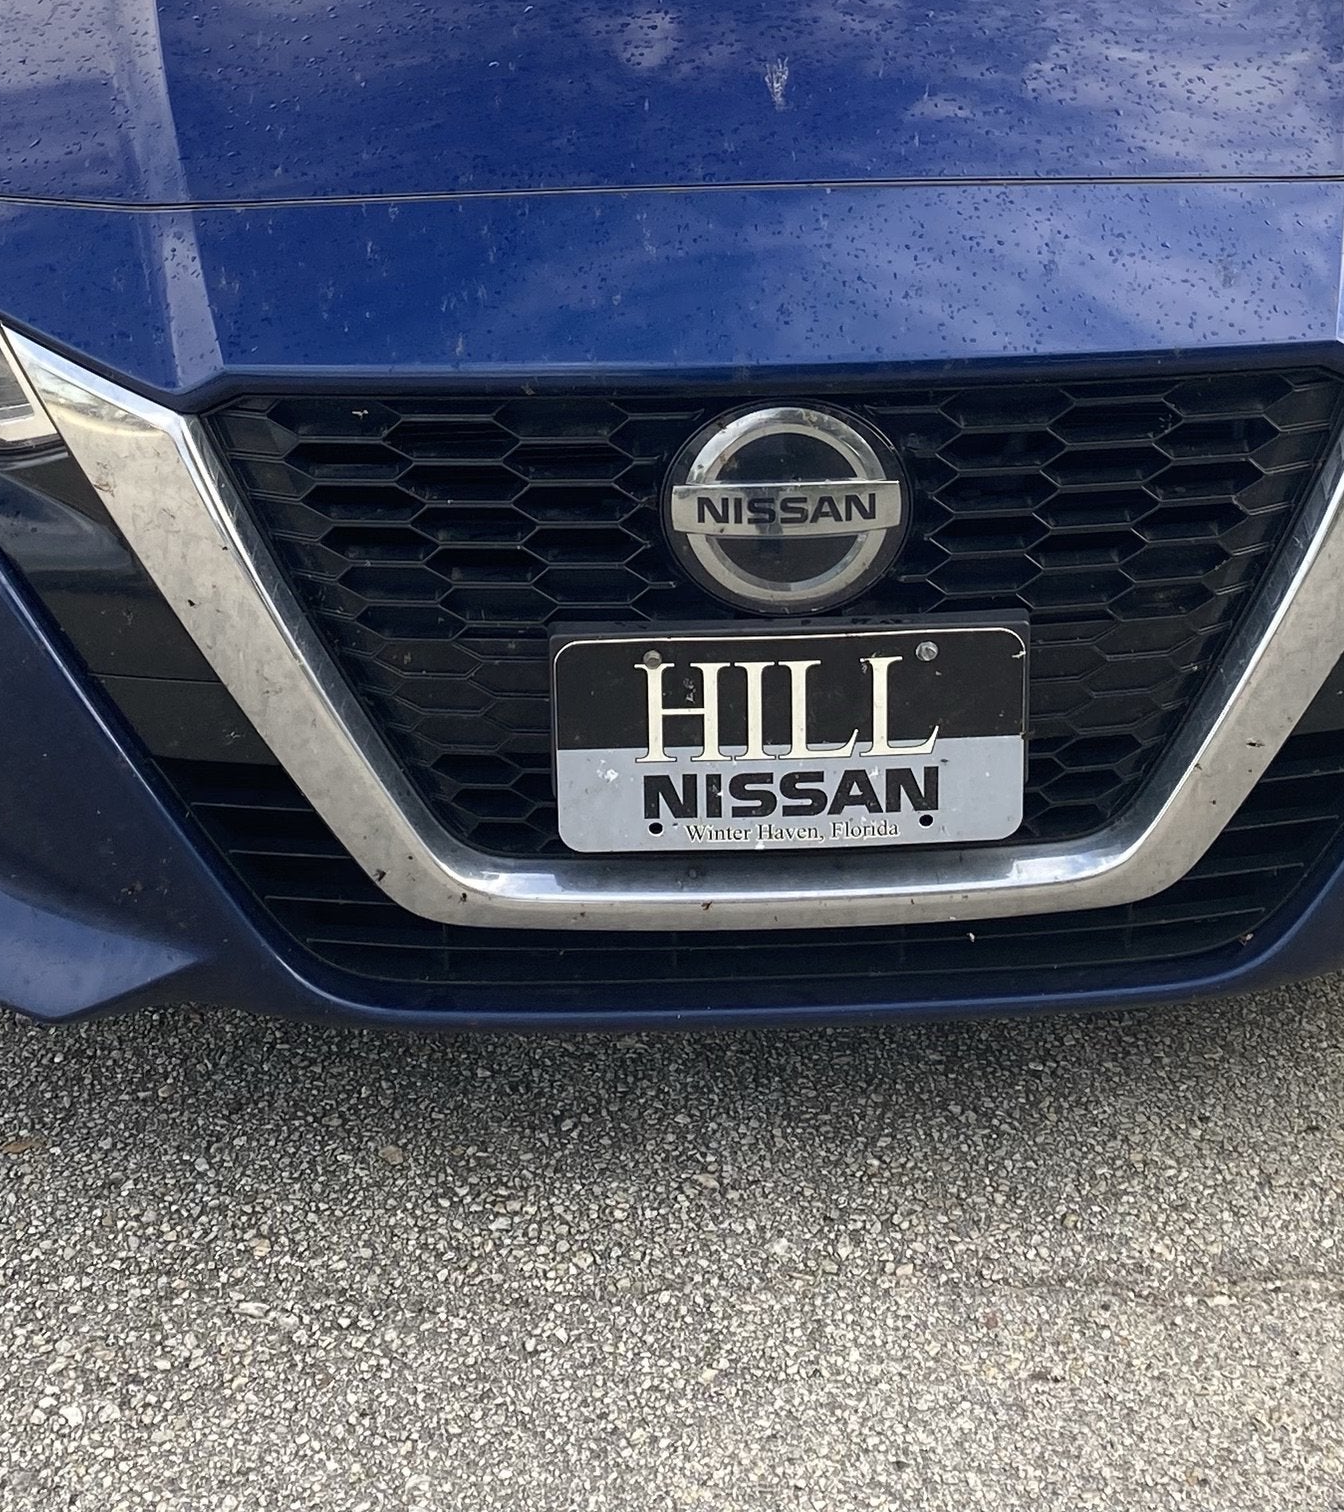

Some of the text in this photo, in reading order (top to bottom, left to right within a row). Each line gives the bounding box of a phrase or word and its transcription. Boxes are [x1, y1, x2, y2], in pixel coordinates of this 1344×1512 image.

[696, 492, 876, 525] NISSAN
[634, 655, 940, 763] HILL
[642, 766, 940, 820] NISSAN
[684, 820, 899, 843] Winter Haven, Florida
